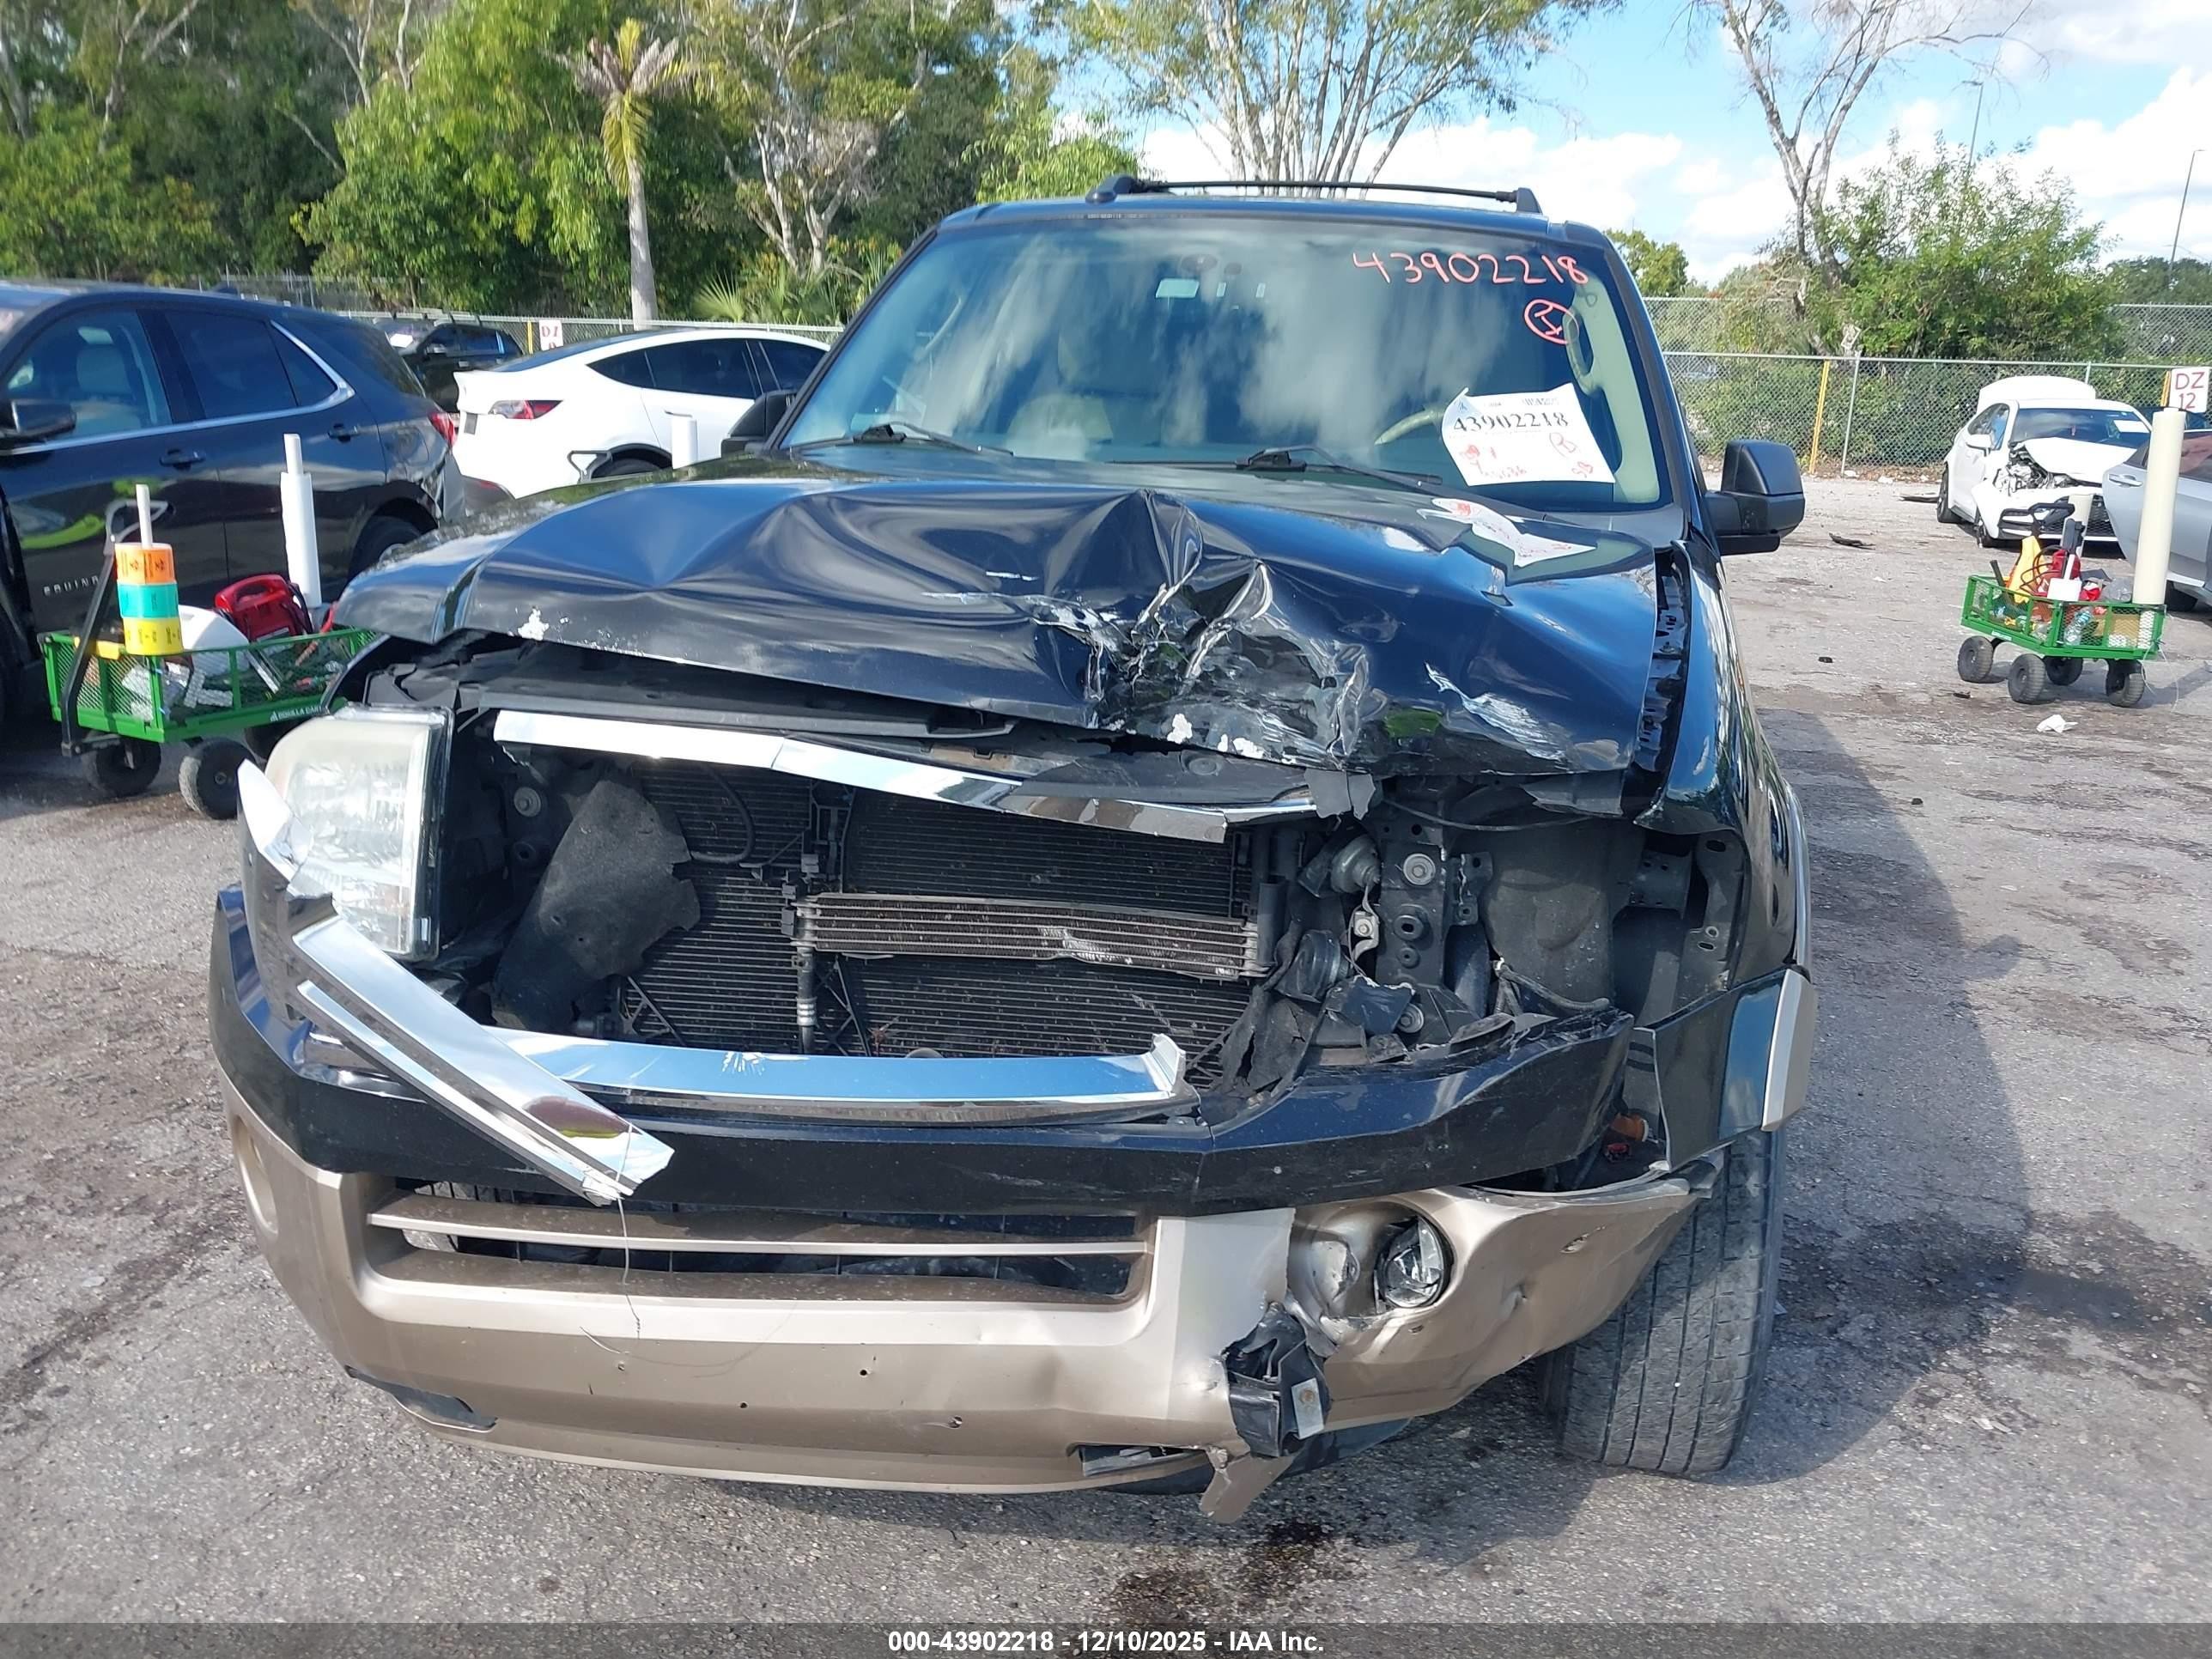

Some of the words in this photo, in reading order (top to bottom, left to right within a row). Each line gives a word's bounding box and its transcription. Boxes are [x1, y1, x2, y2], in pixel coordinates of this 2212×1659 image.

[1352, 252, 1589, 284] 43902218
[2174, 372, 2205, 390] DZ
[2179, 392, 2196, 409] 12
[1453, 412, 1569, 432] 43902218
